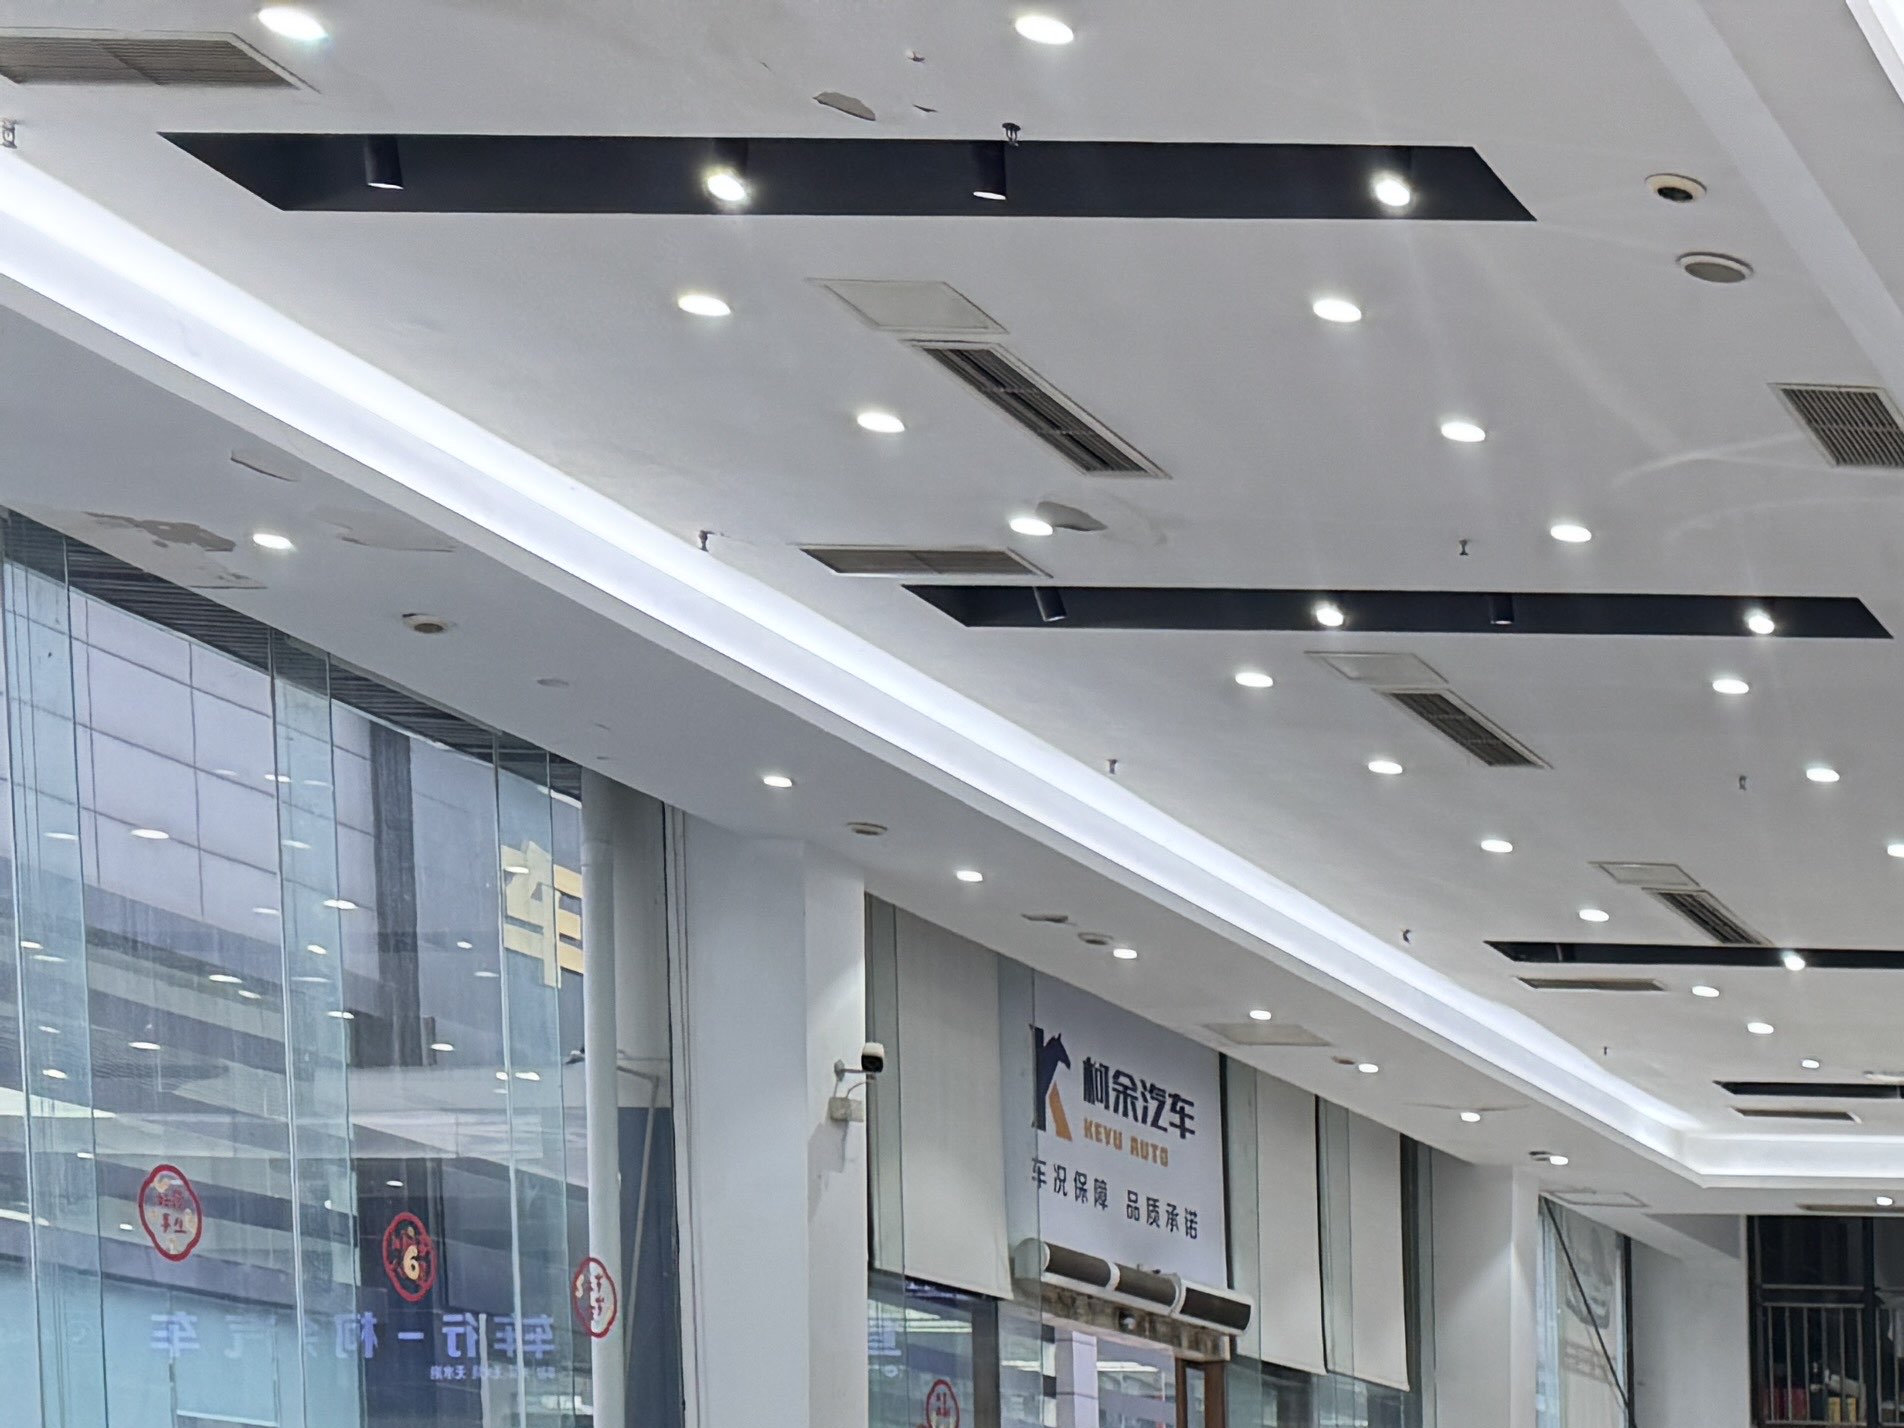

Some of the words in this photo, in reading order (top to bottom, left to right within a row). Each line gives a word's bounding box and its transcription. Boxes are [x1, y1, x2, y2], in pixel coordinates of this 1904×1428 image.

[1082, 1057, 1195, 1139] 柯余汽车
[1083, 1118, 1123, 1151] KEYU
[1130, 1136, 1168, 1167] AUTO
[1032, 1158, 1108, 1211] 车况保障
[1126, 1190, 1197, 1239] 品质承诺
